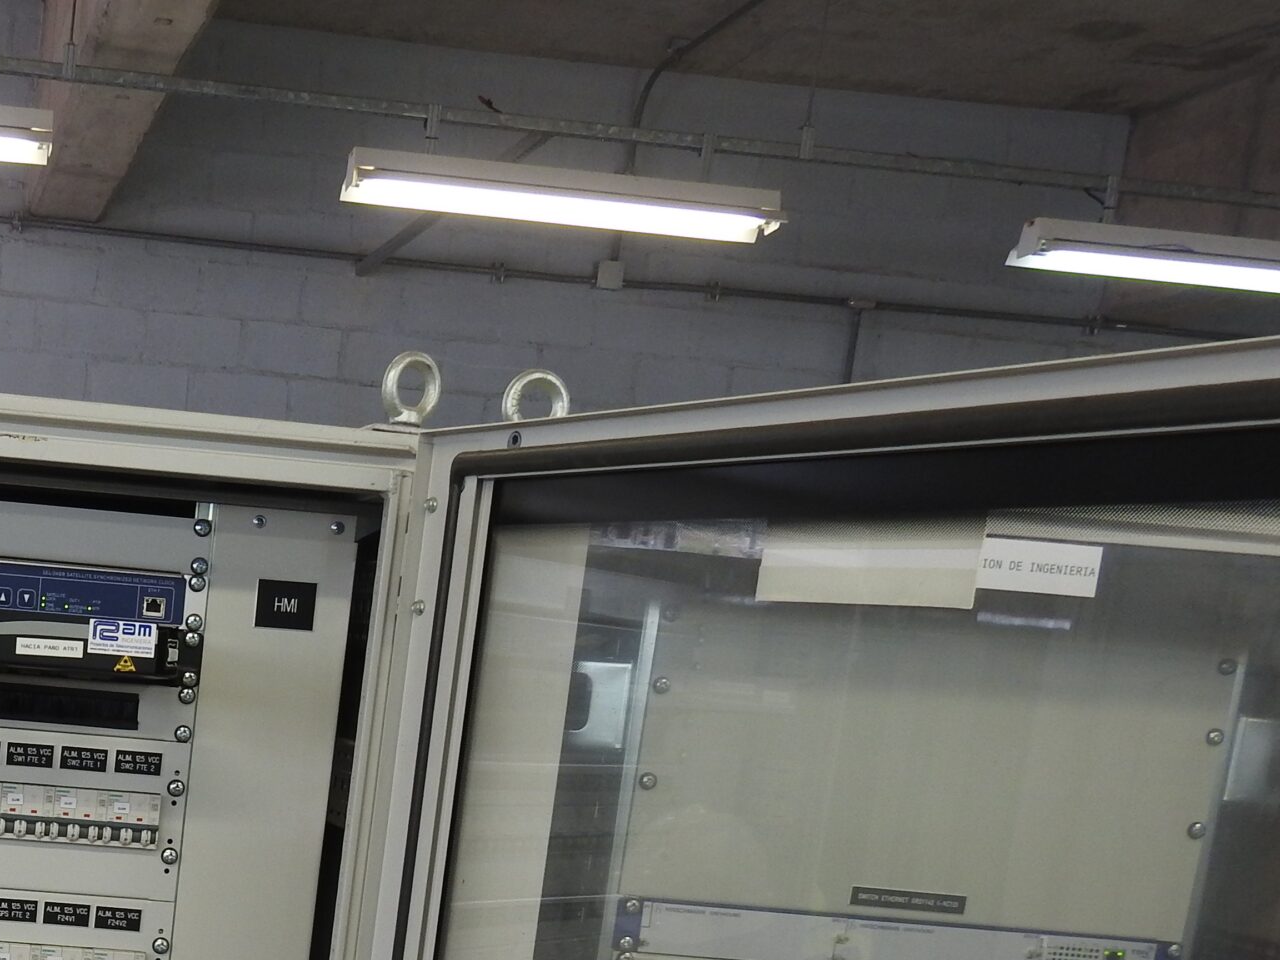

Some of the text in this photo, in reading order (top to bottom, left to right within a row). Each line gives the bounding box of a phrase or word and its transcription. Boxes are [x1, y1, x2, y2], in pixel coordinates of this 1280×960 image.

[1009, 561, 1022, 572] DE
[1030, 562, 1096, 578] INGENIERIA
[274, 596, 298, 614] HMI
[82, 760, 93, 768] FTE
[107, 919, 126, 927] F24V2
